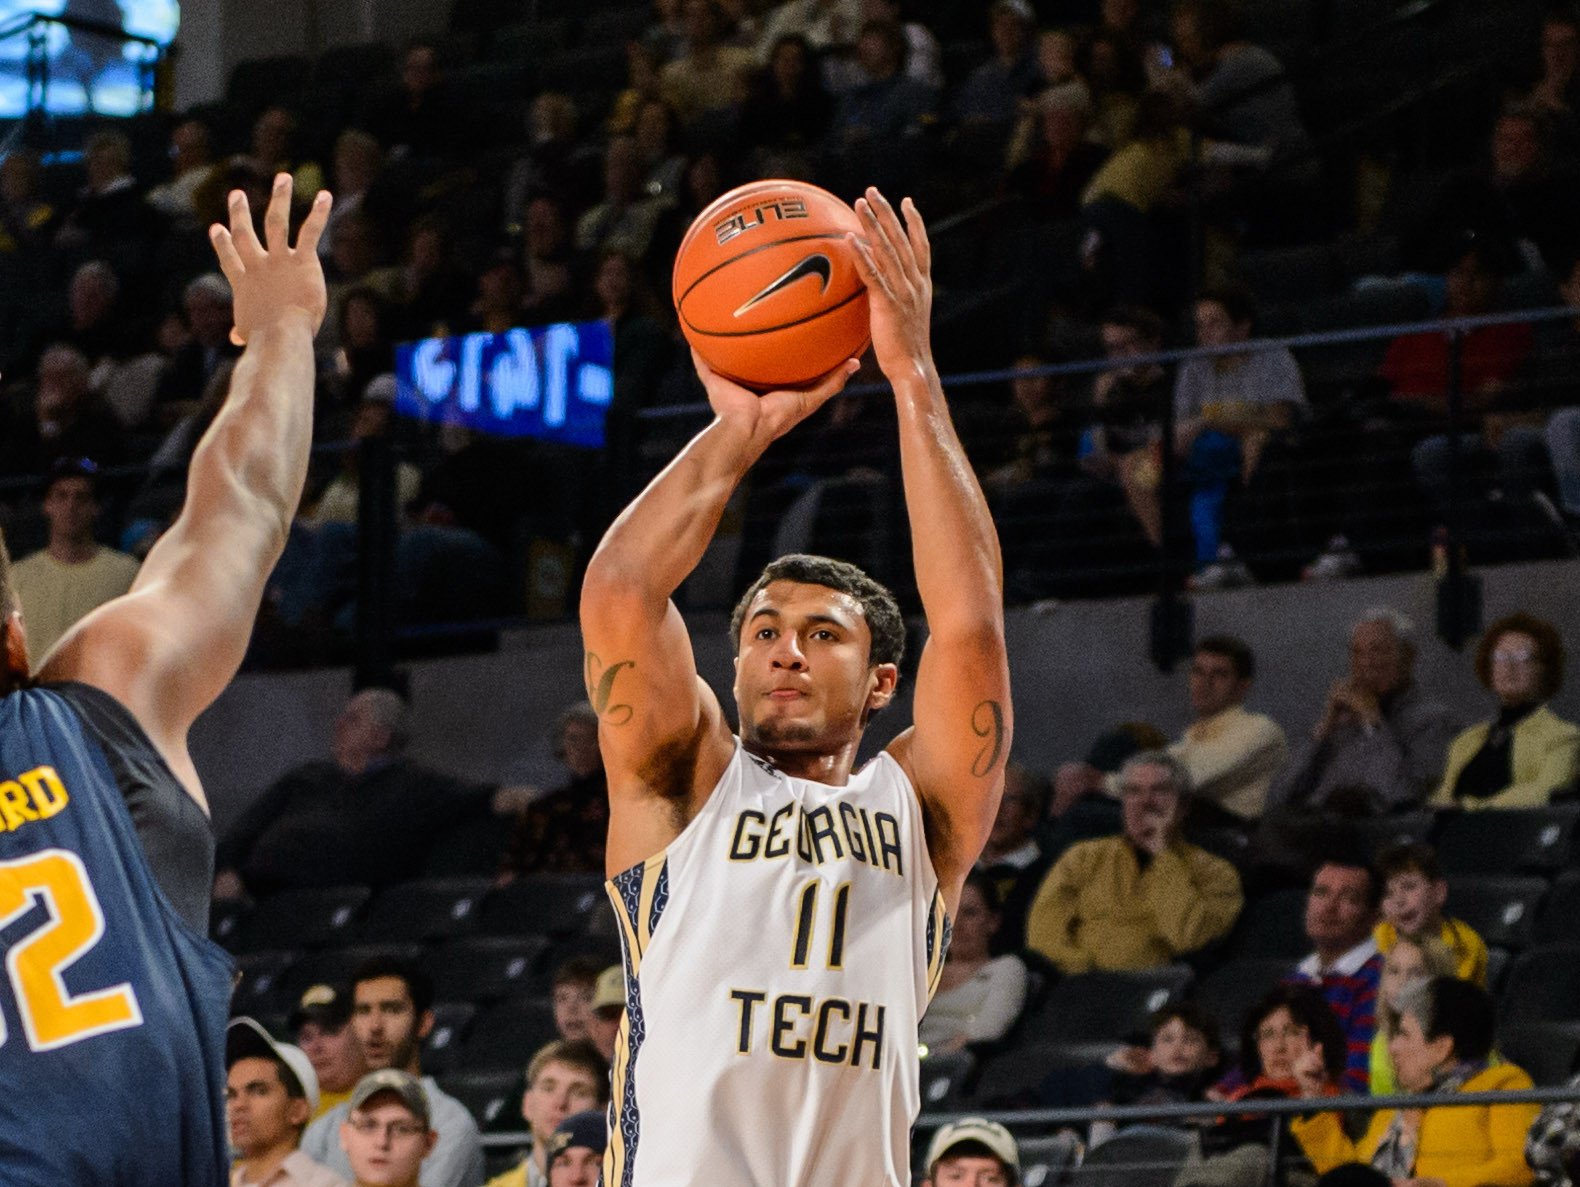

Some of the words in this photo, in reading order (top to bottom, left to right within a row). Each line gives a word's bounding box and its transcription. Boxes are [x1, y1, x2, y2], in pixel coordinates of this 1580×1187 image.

[714, 200, 808, 246] ELITE
[0, 765, 69, 832] RD
[728, 800, 903, 877] GEORGIA
[0, 848, 144, 1052] 2
[789, 877, 852, 971] 11
[729, 987, 887, 1071] TECH
